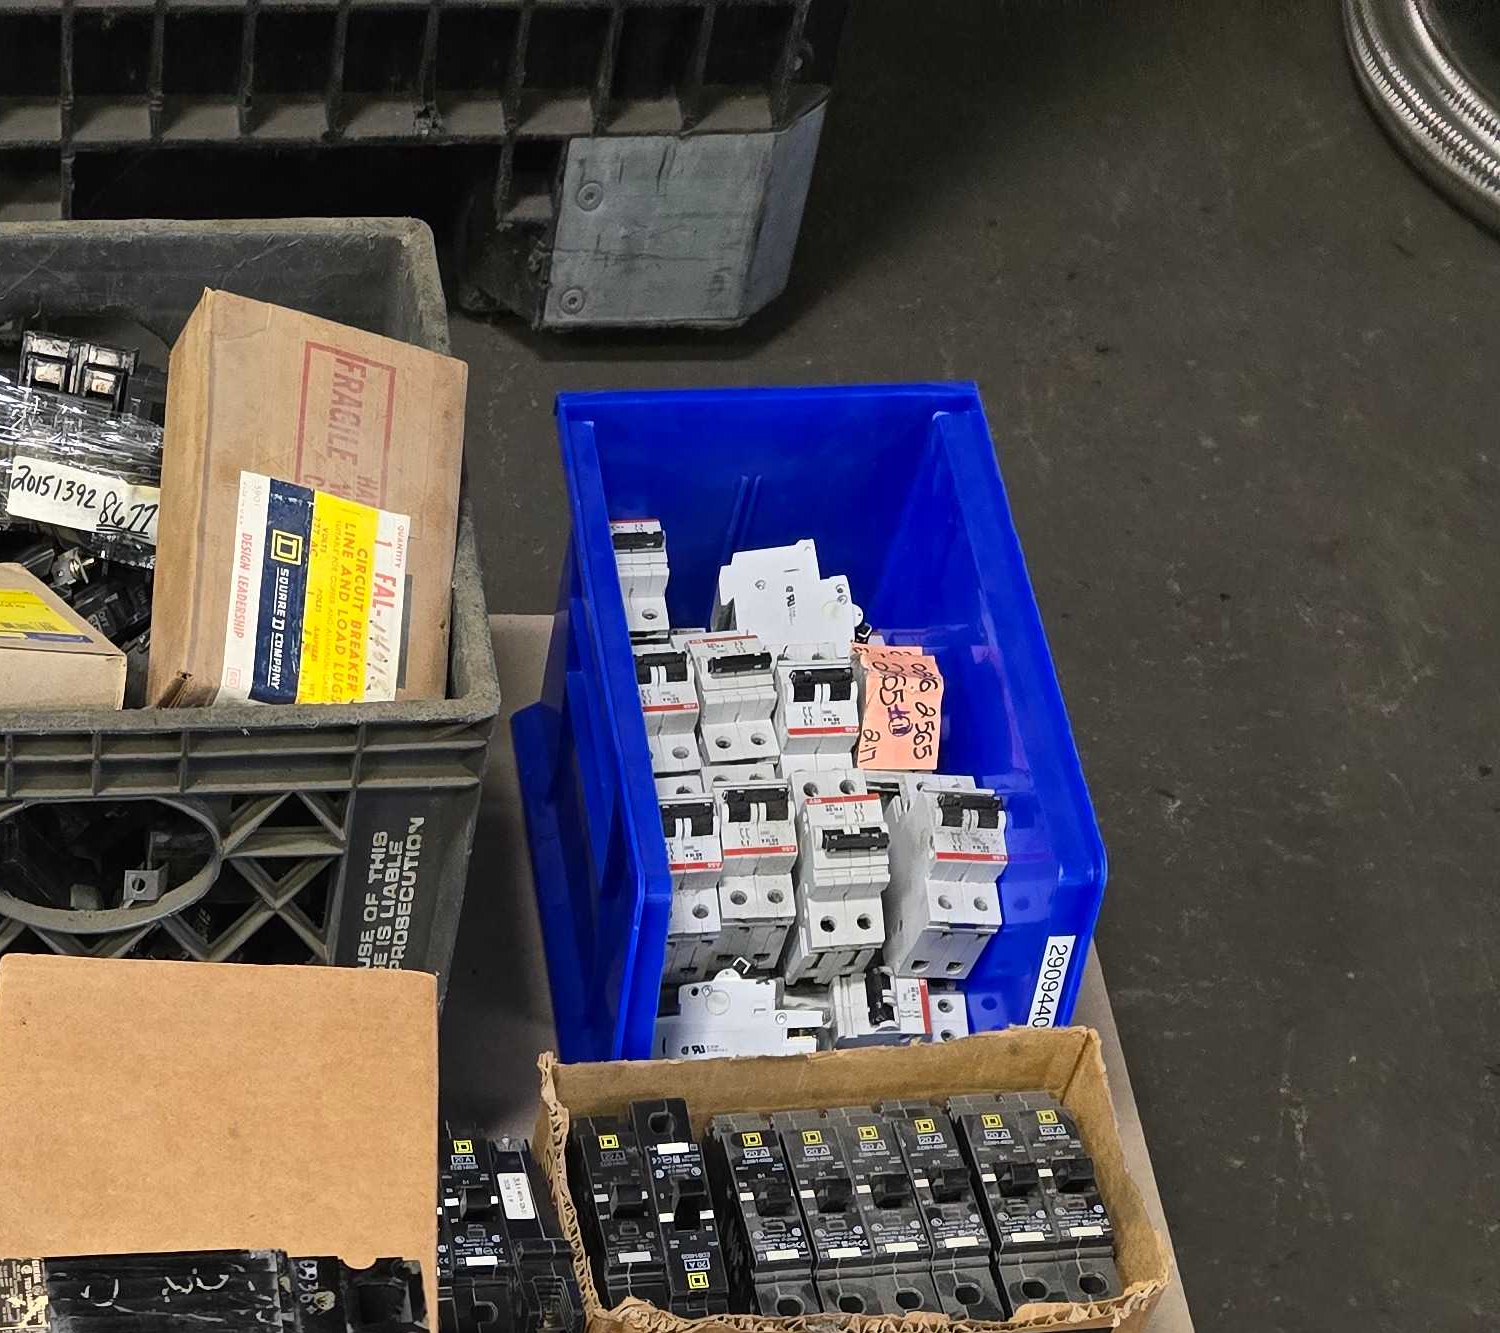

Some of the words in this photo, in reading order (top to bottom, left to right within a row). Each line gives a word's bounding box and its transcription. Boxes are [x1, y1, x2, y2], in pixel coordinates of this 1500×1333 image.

[326, 356, 368, 466] FRAGILE
[241, 532, 253, 574] DESIGN
[344, 522, 357, 562] LINE
[276, 568, 290, 617] SQUARE
[341, 566, 353, 605] AND
[356, 547, 368, 613] CIRCUIT
[232, 575, 251, 640] LEADERSHIP
[334, 608, 350, 657] LOAD
[268, 632, 285, 692] COMPANY
[348, 617, 366, 700] BREAKER
[367, 831, 389, 884] THIS
[379, 840, 404, 919] LIABLE
[363, 893, 379, 922] OF
[375, 925, 392, 946] IS
